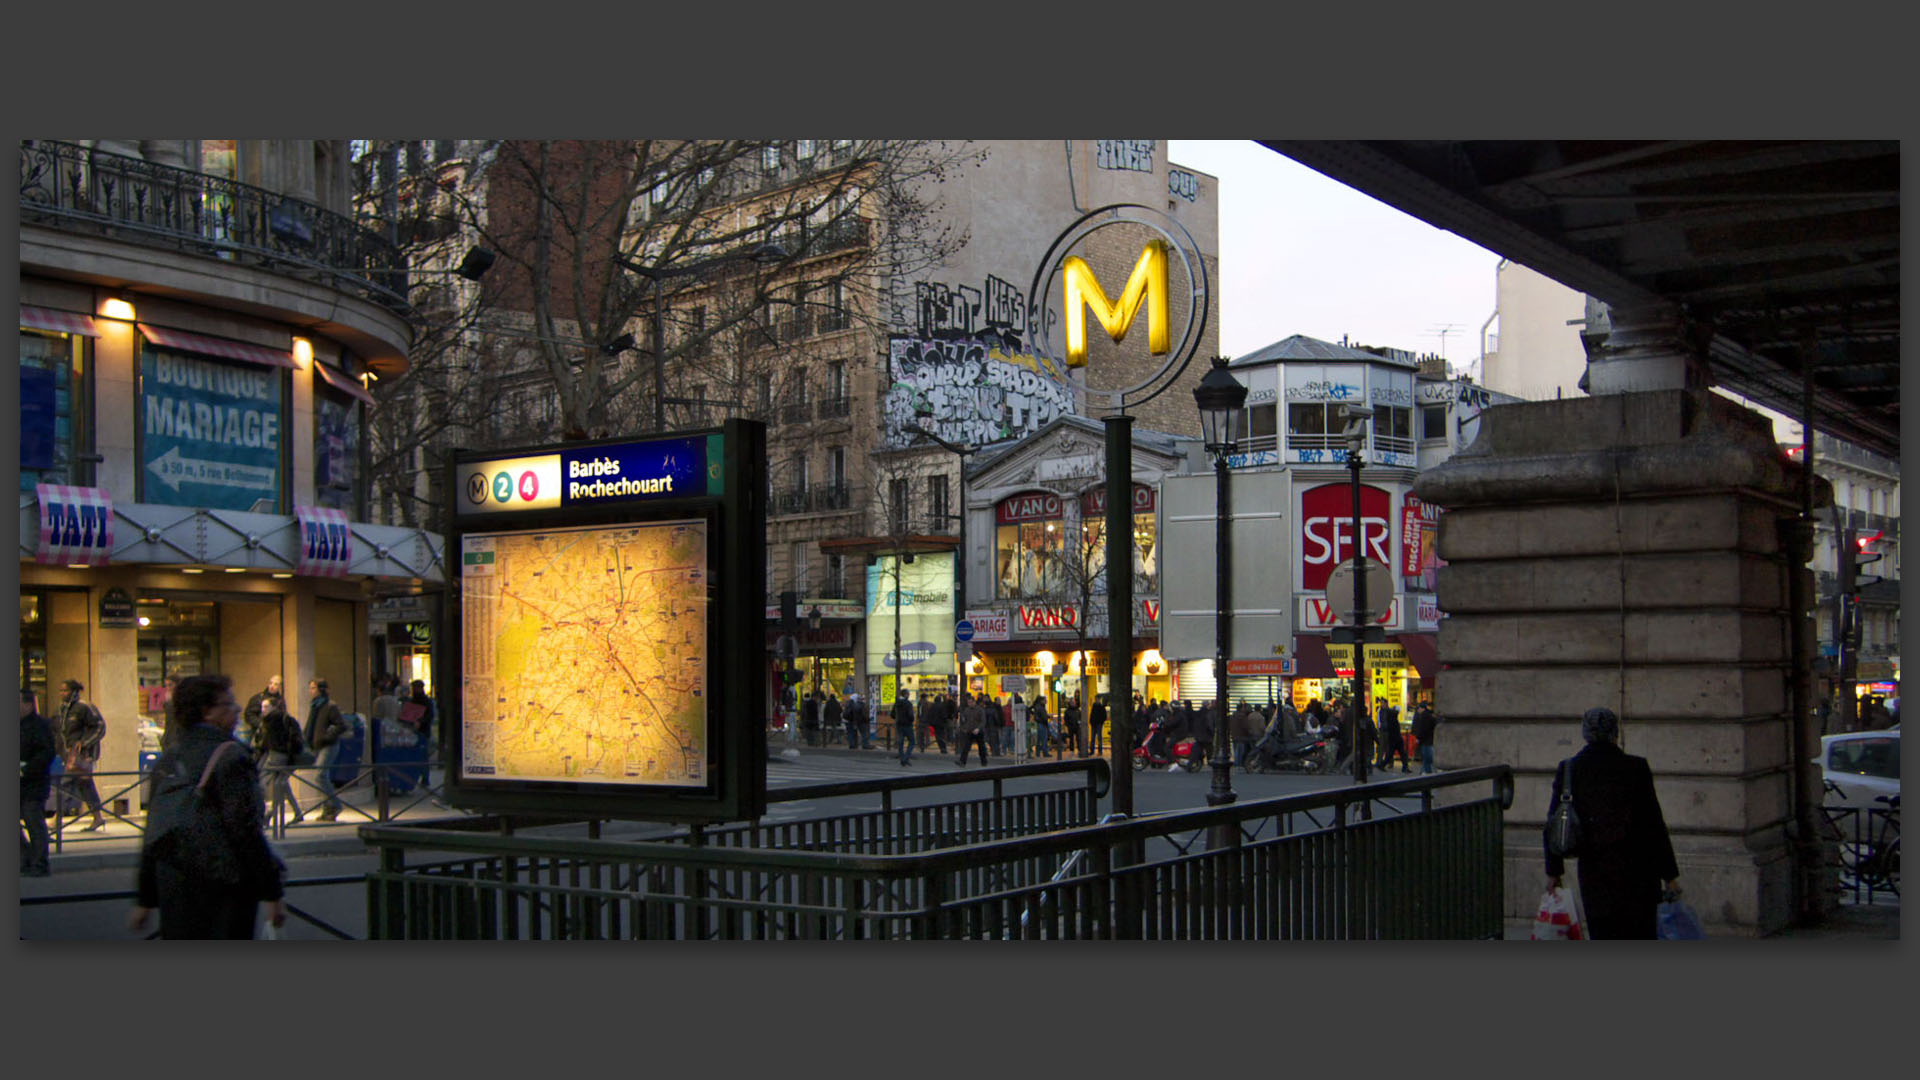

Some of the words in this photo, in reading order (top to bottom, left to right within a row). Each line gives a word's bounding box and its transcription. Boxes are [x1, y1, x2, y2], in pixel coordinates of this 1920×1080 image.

[1063, 240, 1170, 368] M
[157, 353, 268, 399] BOUTIQUE
[146, 395, 277, 449] MARIAGE
[569, 457, 620, 478] Barbès
[498, 477, 508, 497] 2
[523, 477, 534, 496] 4
[569, 474, 673, 499] Rochechouart
[1007, 498, 1058, 516] VANO
[48, 502, 106, 548] TATI
[305, 521, 347, 561] TATI
[1304, 517, 1390, 564] SFR
[1404, 511, 1414, 545] SUPER
[1408, 518, 1421, 572] DISCOUNT
[1020, 605, 1076, 627] VANO
[889, 650, 930, 660] SMSUNG
[1368, 648, 1392, 659] FRANCE
